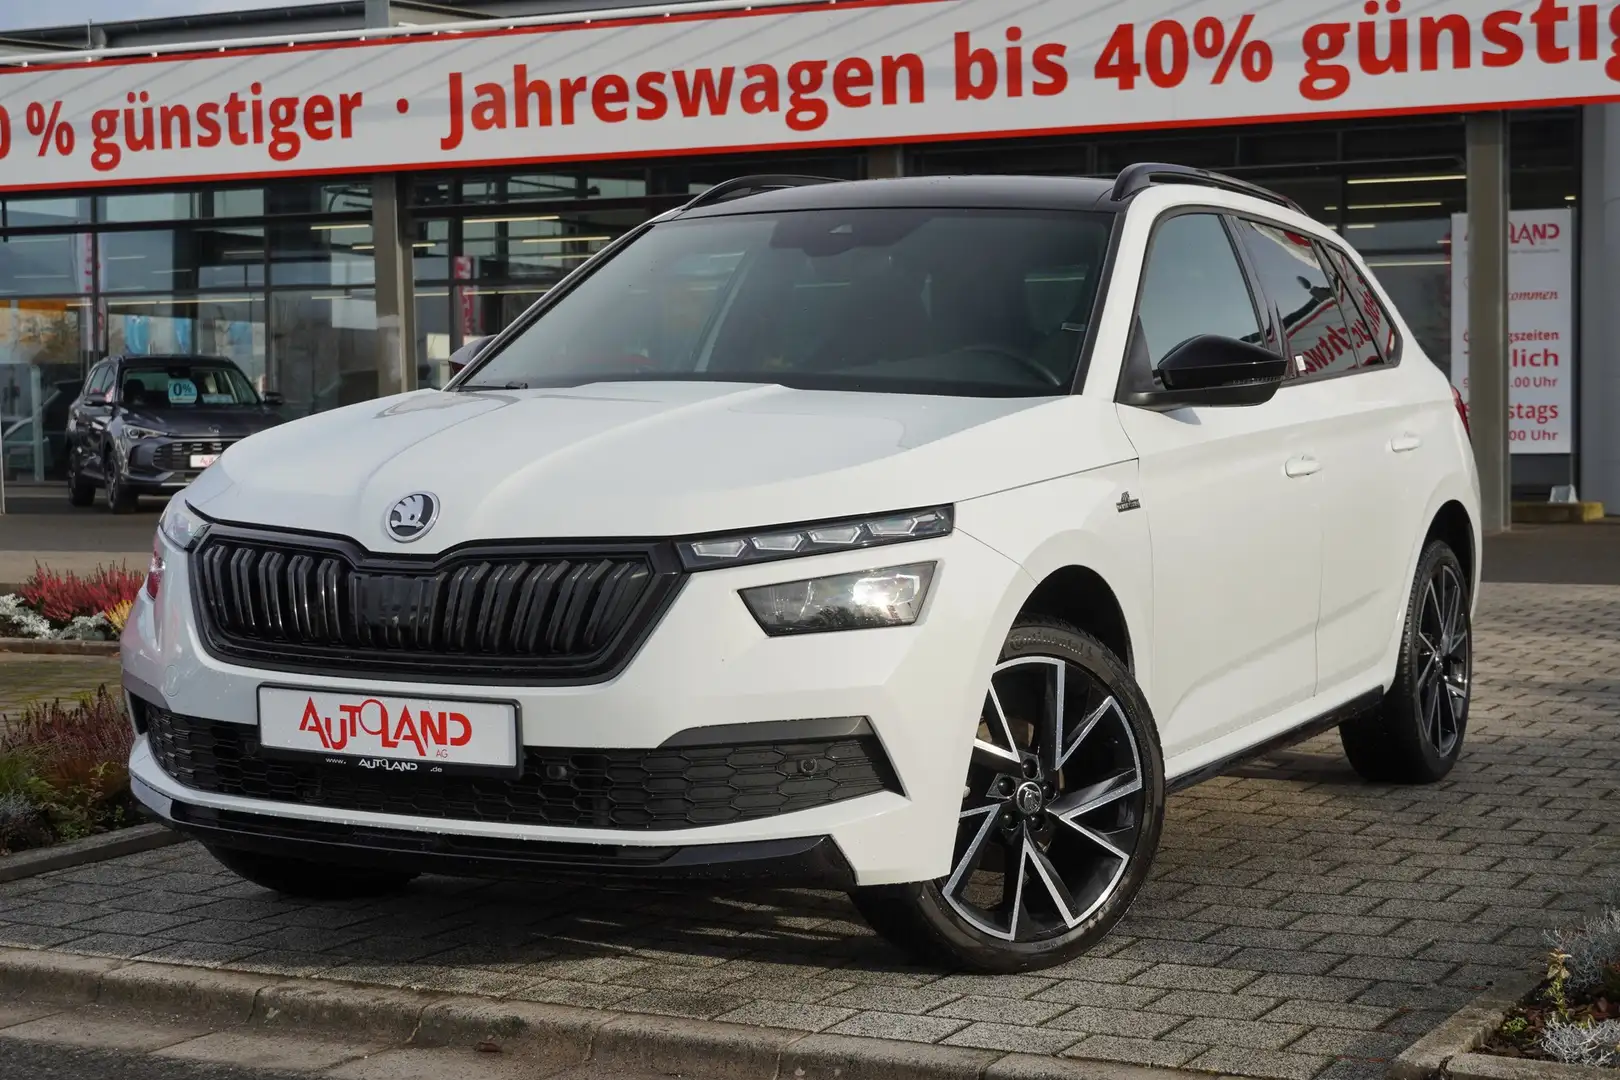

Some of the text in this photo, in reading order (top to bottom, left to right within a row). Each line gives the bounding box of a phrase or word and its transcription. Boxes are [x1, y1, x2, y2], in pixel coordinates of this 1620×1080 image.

[91, 83, 363, 171] günstiger
[440, 53, 925, 151] Jahreswagen
[955, 26, 1069, 101] bis
[1095, 14, 1273, 91] 40%
[1510, 376, 1557, 387] .00 Uhr
[1531, 430, 1557, 441] Uhr
[299, 697, 472, 756] AUTOLAND
[436, 748, 449, 759] AG
[358, 758, 418, 772] AUTOLAND
[430, 765, 443, 773] .de
